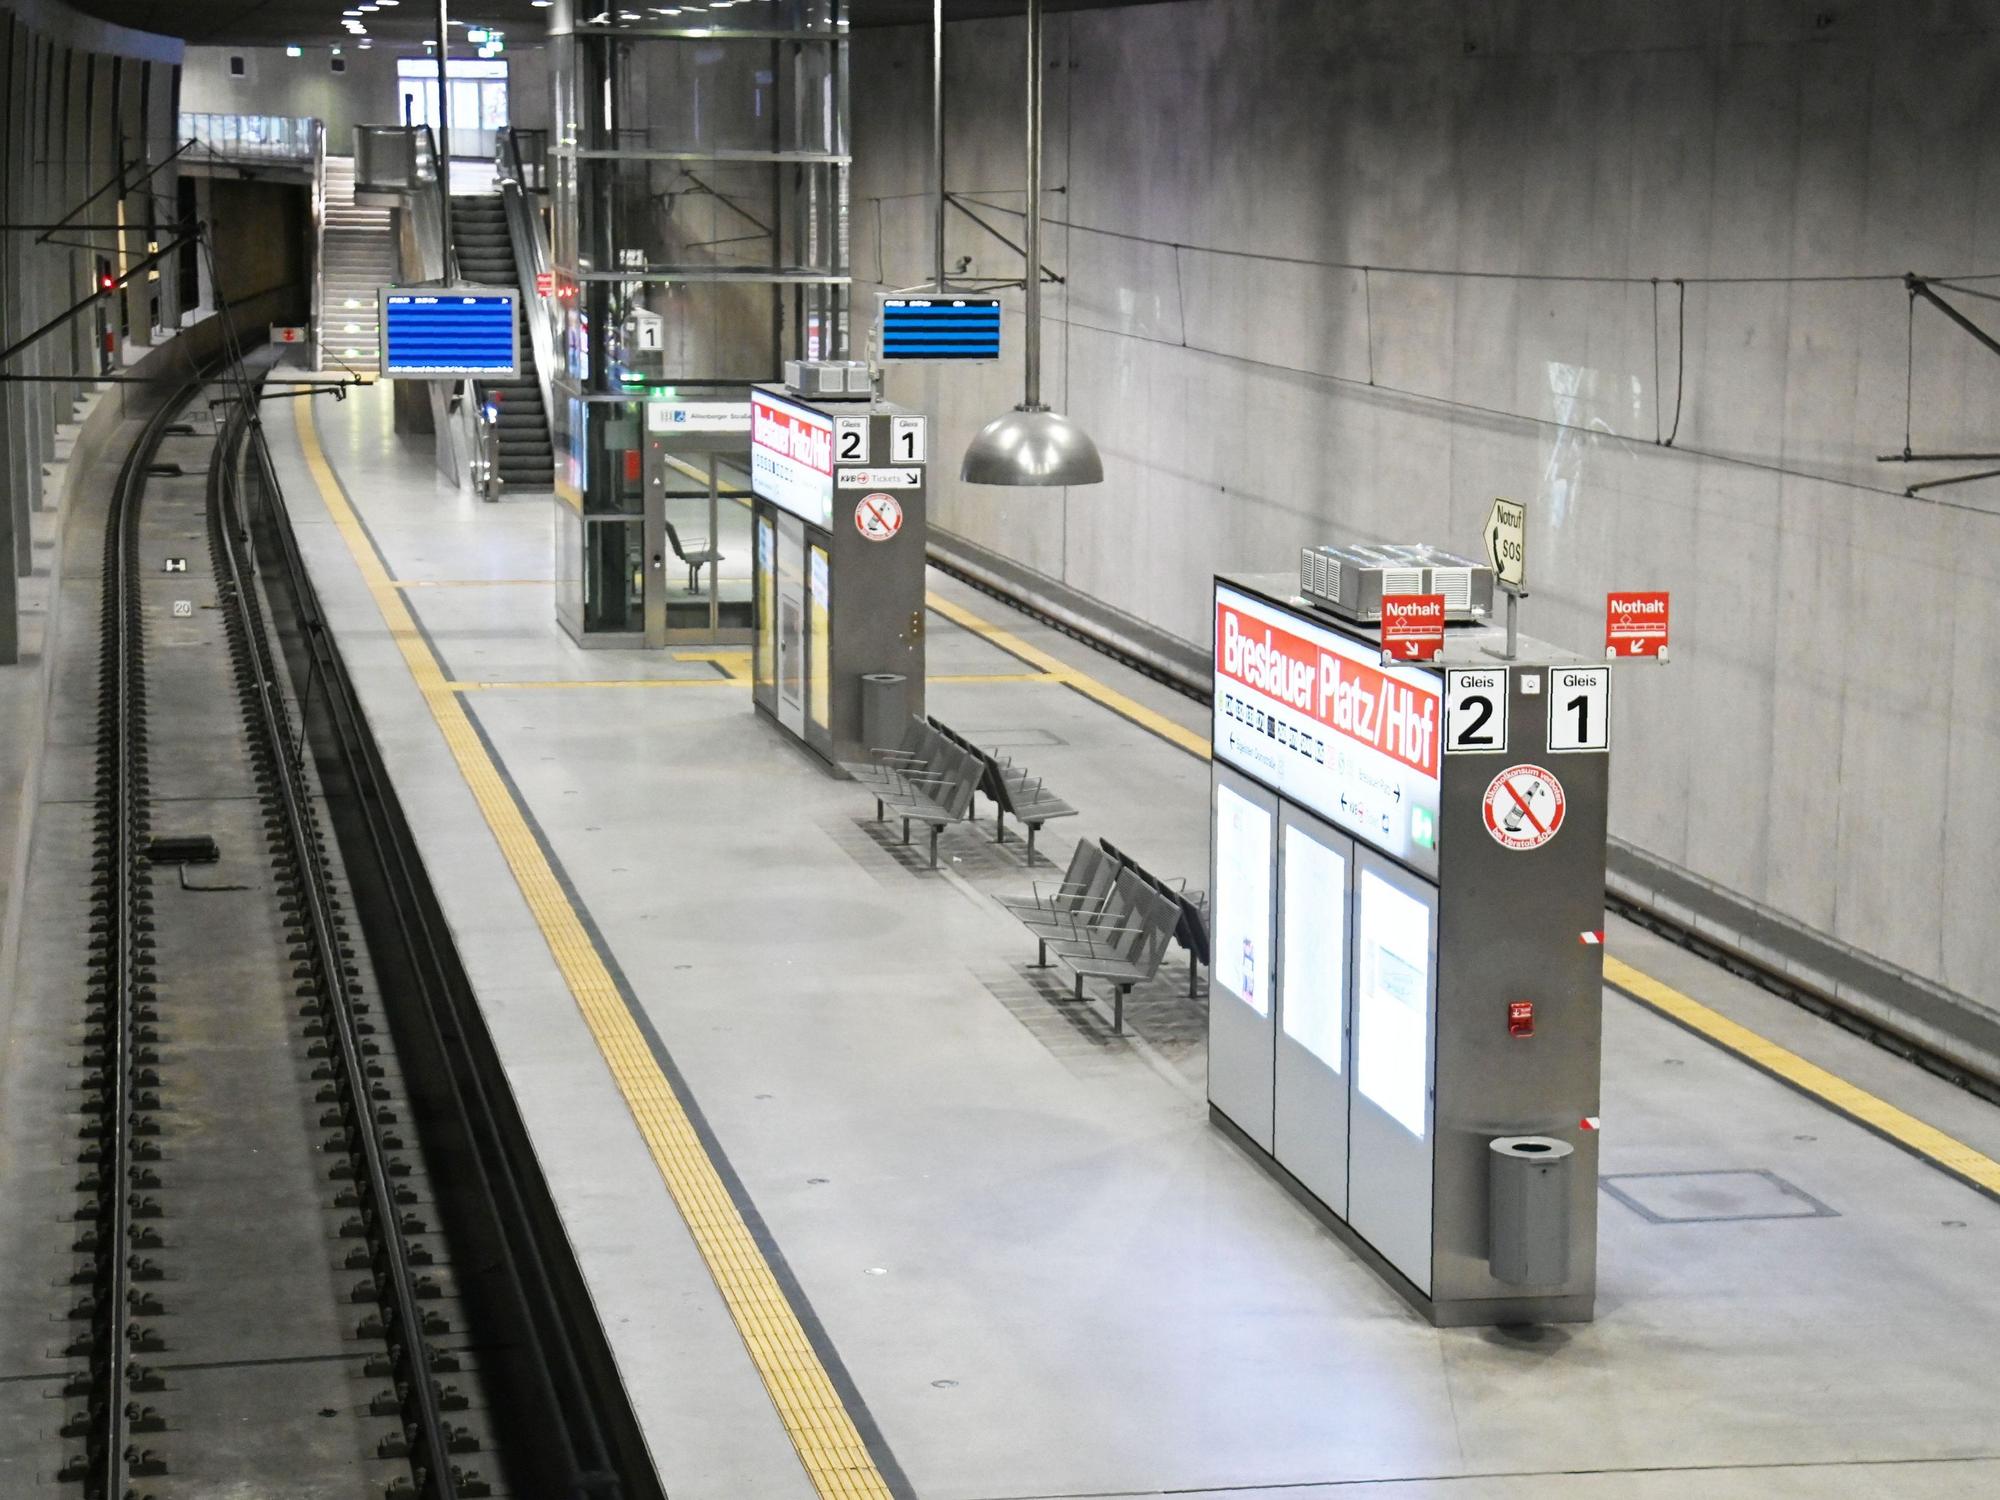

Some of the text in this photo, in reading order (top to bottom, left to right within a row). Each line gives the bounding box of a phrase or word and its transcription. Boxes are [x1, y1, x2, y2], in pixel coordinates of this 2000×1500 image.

[646, 328, 654, 346] 1
[841, 432, 861, 458] 2
[902, 432, 914, 458] 1
[1497, 505, 1522, 529] Notruf
[1503, 539, 1521, 562] SOS
[175, 603, 190, 614] 20
[1386, 602, 1440, 616] Nothalt
[1611, 599, 1665, 614] Nothalt
[1225, 611, 1434, 768] Breslauer Platz/Hbf
[1460, 676, 1494, 688] Gleis
[1563, 675, 1597, 687] Gleis
[1458, 695, 1493, 745] 2
[1567, 695, 1589, 743] 1
[1486, 768, 1562, 806] Alkoholkonsum verboten
